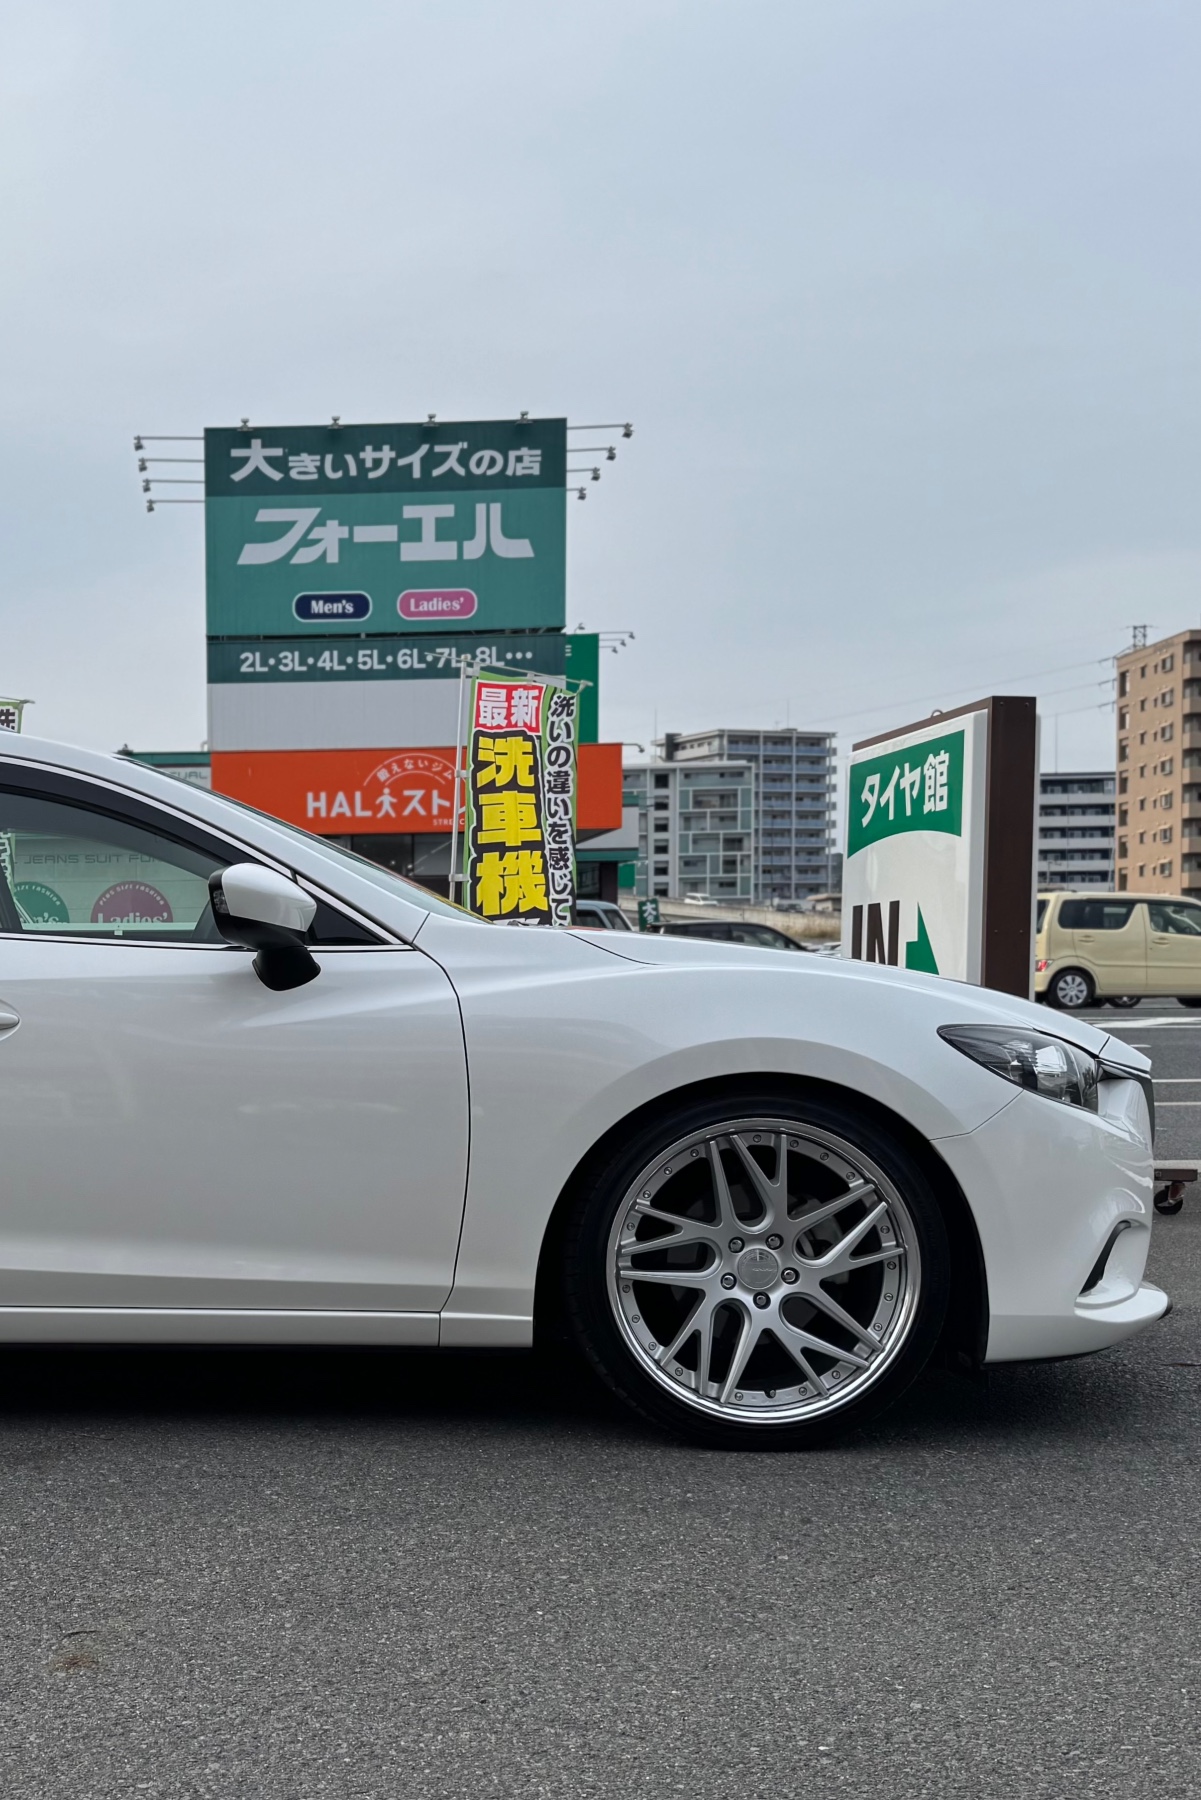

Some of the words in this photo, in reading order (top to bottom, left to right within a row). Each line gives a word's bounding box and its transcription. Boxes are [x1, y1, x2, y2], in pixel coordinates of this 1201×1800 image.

[230, 438, 542, 482] 大きいサイズの店
[236, 502, 535, 565] フォーエル
[310, 599, 355, 615] Men's
[409, 597, 465, 612] Ladies'
[479, 688, 540, 728] 最新
[306, 791, 373, 818] HAL
[860, 749, 950, 829] タイヤ館
[476, 736, 549, 917] 洗車機
[545, 694, 577, 927] 洗いの違いを感じて
[24, 854, 80, 864] JEANS
[84, 854, 121, 863] SUIT
